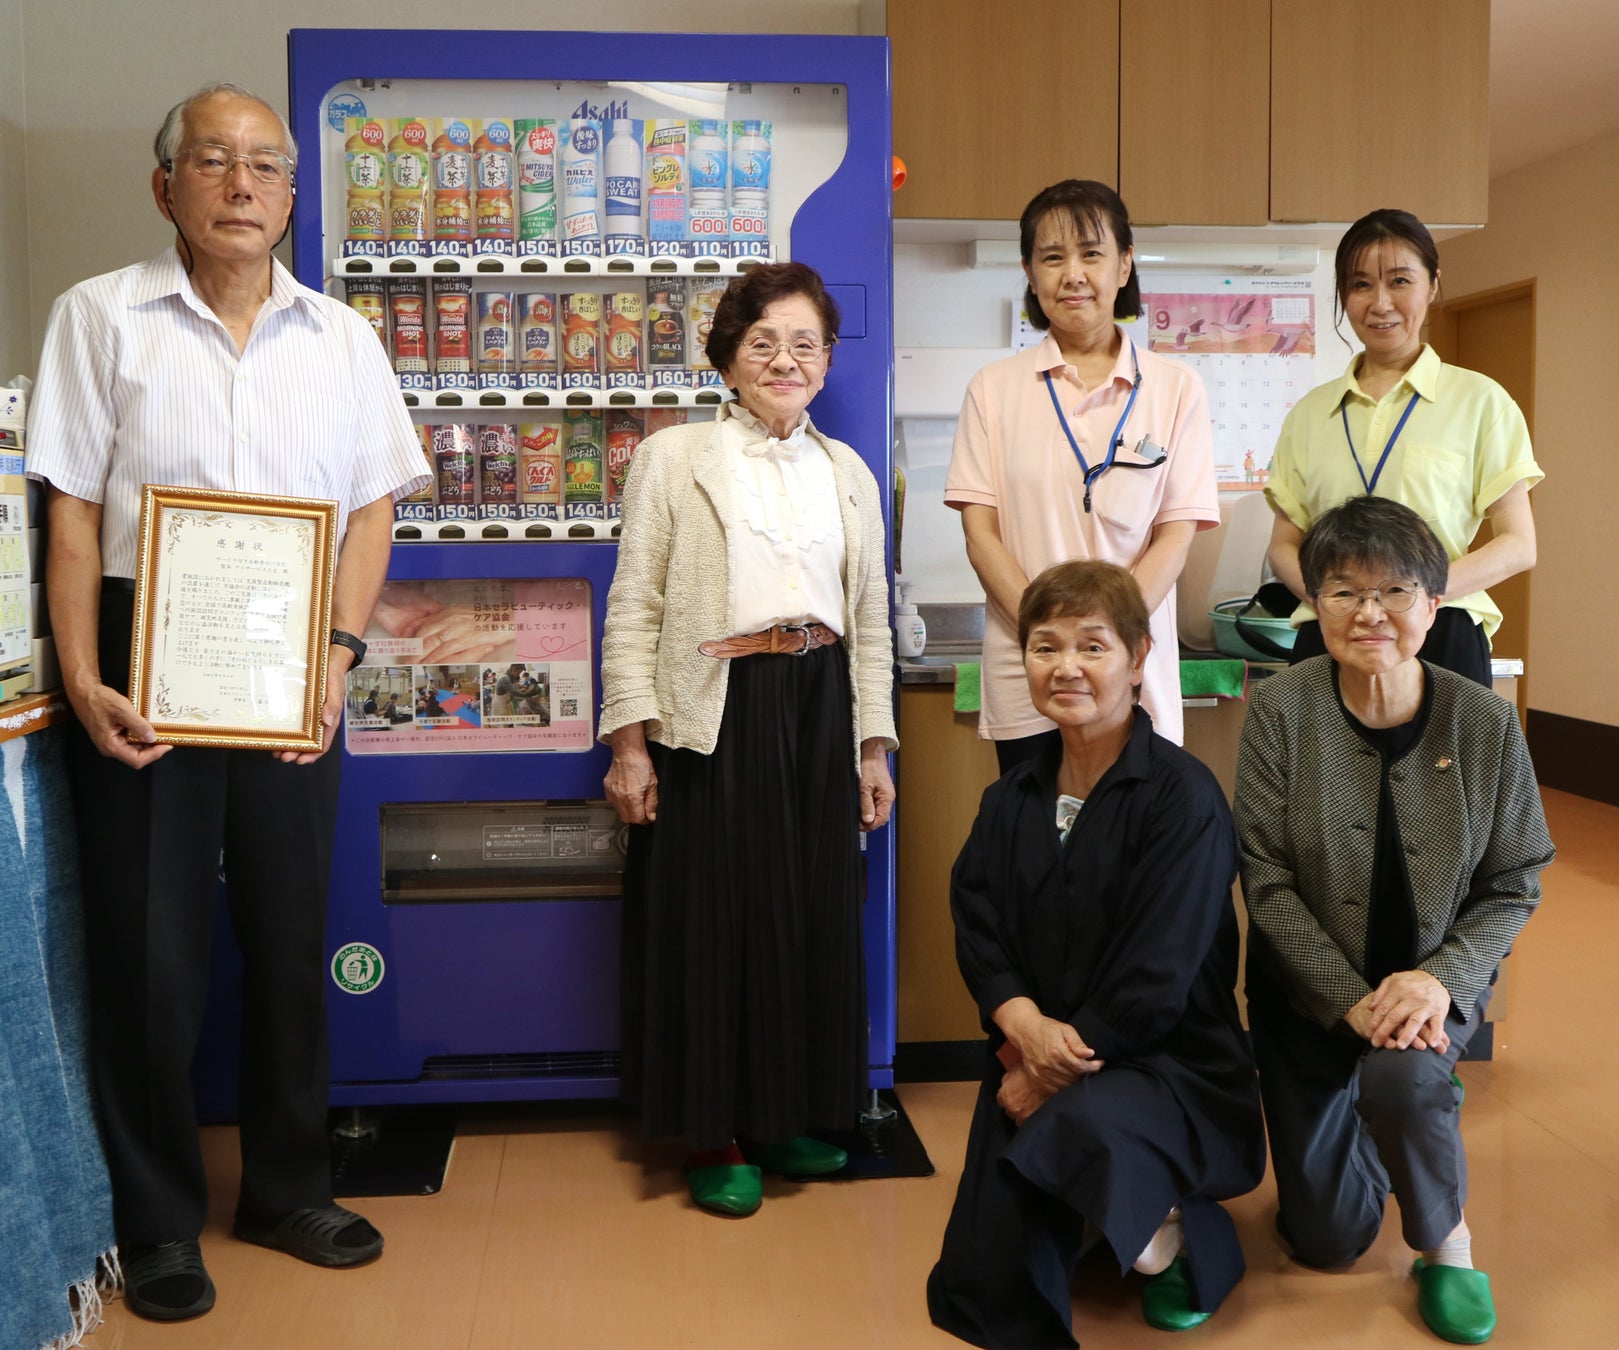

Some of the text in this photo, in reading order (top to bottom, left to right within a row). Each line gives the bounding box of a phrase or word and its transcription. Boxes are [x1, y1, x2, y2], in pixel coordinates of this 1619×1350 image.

[572, 100, 628, 120] Asahi
[363, 129, 382, 138] 600
[404, 129, 424, 138] 600
[449, 129, 468, 138] 600
[489, 129, 508, 138] 600
[531, 131, 551, 140] スッキリ
[576, 130, 594, 140] 後味
[532, 137, 553, 151] 爽快
[575, 140, 598, 150] すっきり
[360, 154, 373, 186] 十六茶
[401, 154, 414, 186] 十六茶
[446, 154, 460, 186] 麦茶
[486, 154, 500, 186] 麦茶
[566, 176, 593, 186] Water
[654, 173, 680, 183] ソルティ
[351, 209, 381, 218] カラダに
[393, 209, 423, 218] カラダに
[692, 219, 724, 233] 600
[732, 218, 763, 233] 600
[346, 241, 383, 254] 140円
[389, 241, 426, 254] 140円
[430, 241, 466, 254] 140円
[475, 239, 511, 253] 140円
[519, 241, 555, 254] 150円
[564, 241, 600, 254] 150円
[608, 239, 643, 253] 170円
[651, 241, 686, 255] 120円
[693, 242, 727, 255] 110円
[733, 242, 767, 255] 110円
[400, 315, 420, 323] Wonda
[442, 315, 463, 323] Wonda
[1156, 310, 1170, 330] 9
[397, 374, 431, 387] 130円
[438, 373, 474, 387] 130円
[480, 373, 516, 387] 150円
[520, 373, 556, 387] 150円
[564, 373, 599, 386] 130円
[609, 373, 644, 386] 130円
[655, 371, 691, 384] 160円
[482, 432, 514, 454] 濃い
[396, 506, 432, 519] 140円
[438, 505, 474, 518] 150円
[480, 504, 516, 518] 150円
[519, 504, 555, 517] 150円
[567, 504, 603, 517] 140円
[474, 613, 510, 622] ケア協会
[474, 623, 567, 631] の活動を応援しています
